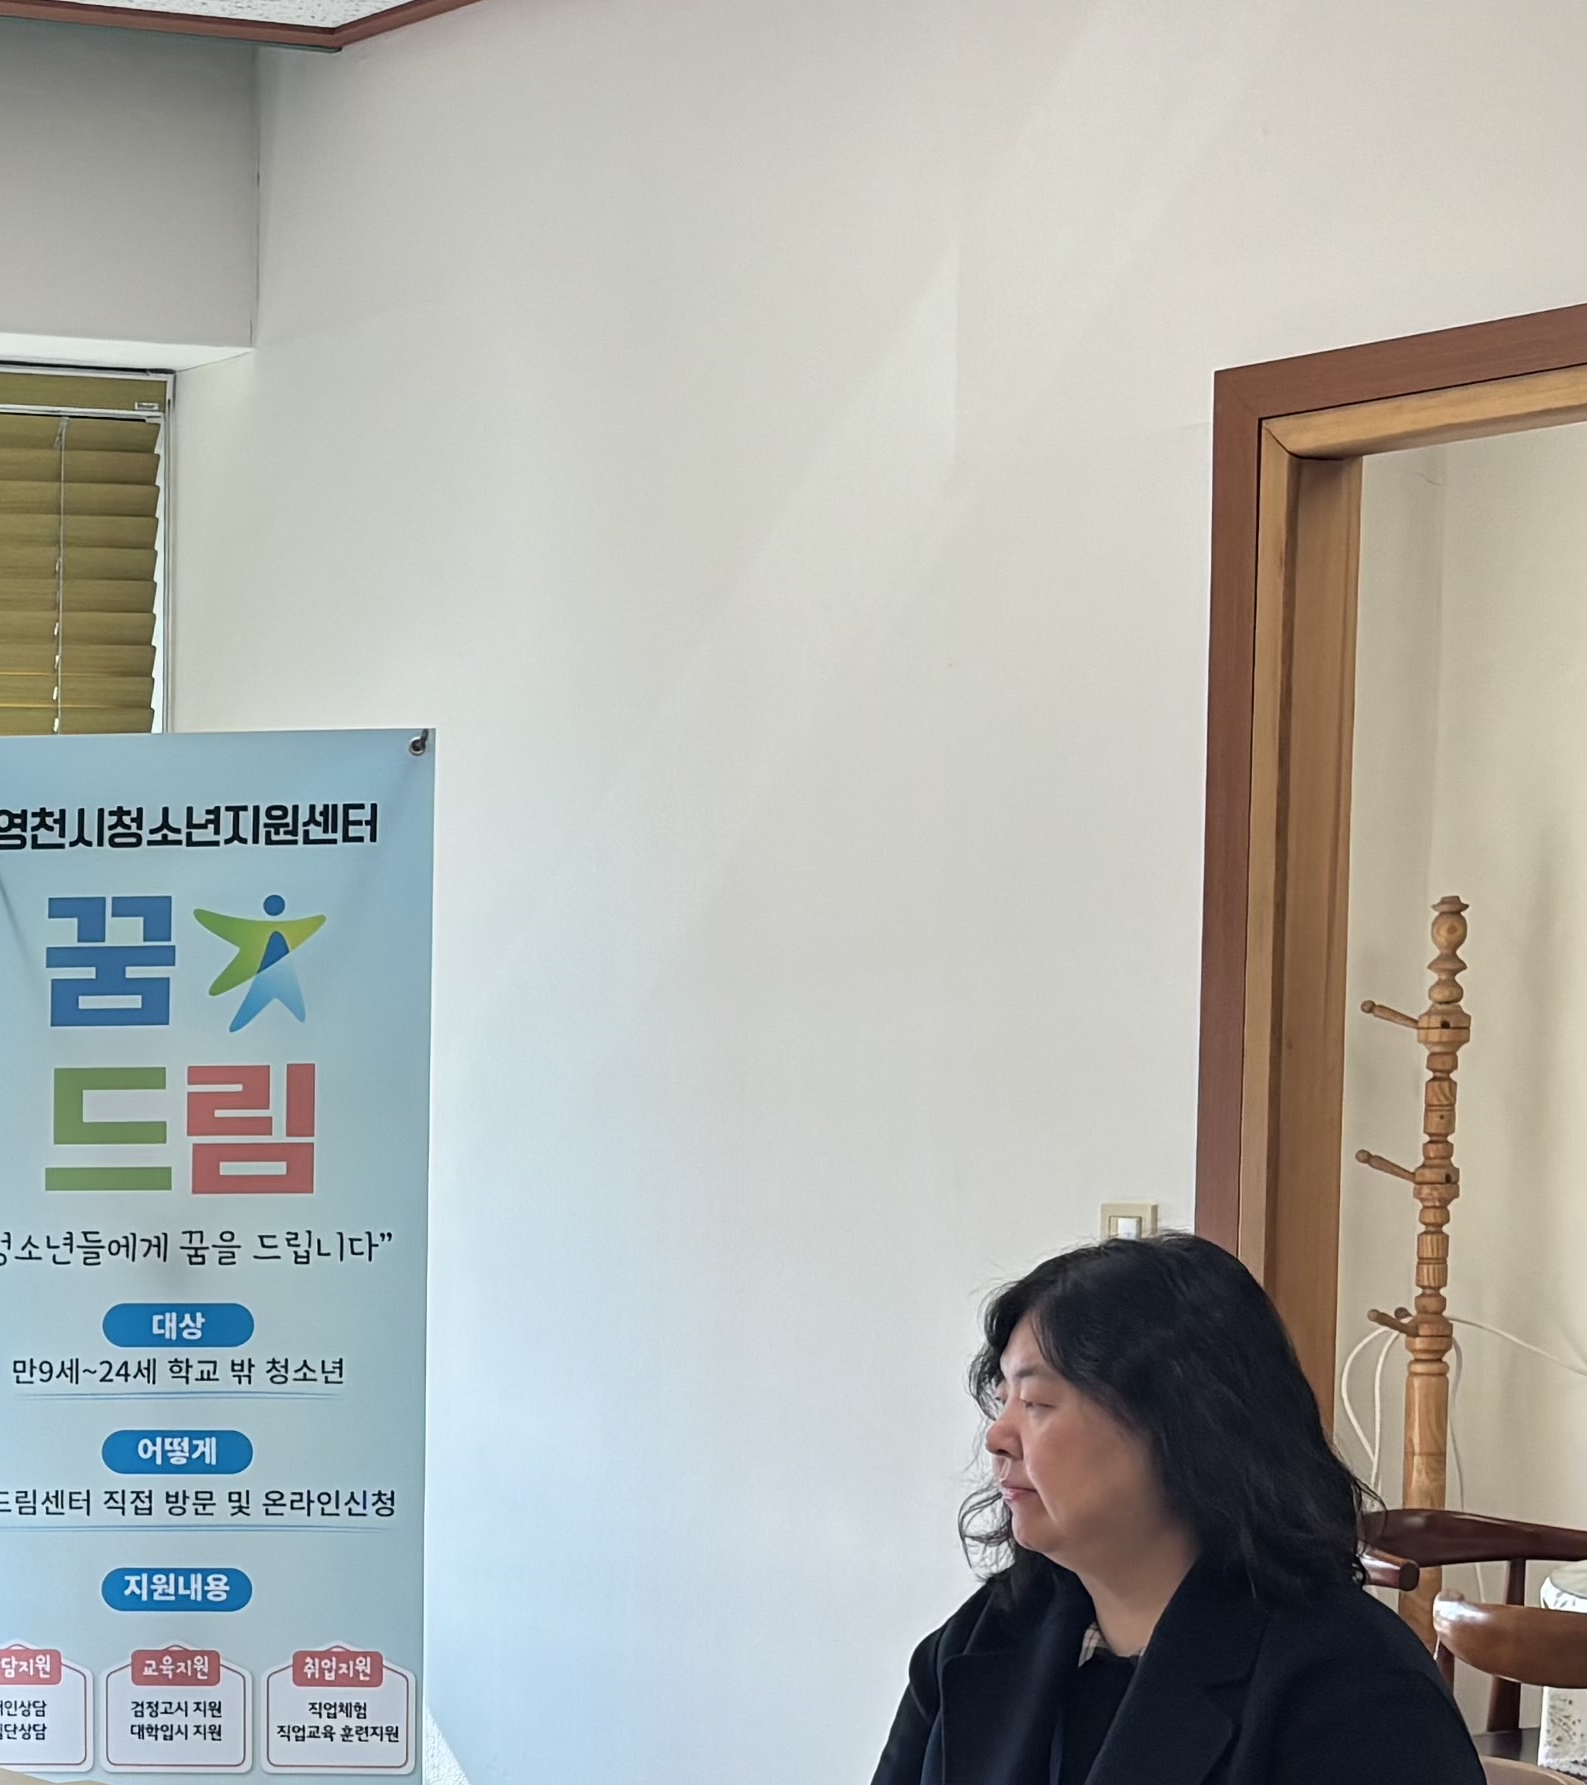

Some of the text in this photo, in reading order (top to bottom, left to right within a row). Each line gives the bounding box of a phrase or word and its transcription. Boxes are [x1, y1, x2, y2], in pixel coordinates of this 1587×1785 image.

[46, 895, 176, 1027] 꿈
[45, 1063, 315, 1195] 드림
[179, 1231, 241, 1266] 꿈을
[152, 1311, 205, 1340] 대상
[12, 1357, 344, 1385] 만9세~24세 학교 밖 청소년
[138, 1436, 217, 1466] 어떻게
[104, 1490, 154, 1517] 직접
[165, 1490, 215, 1517] 방문
[228, 1490, 251, 1517] 및
[262, 1490, 396, 1517] 온라인신청
[124, 1573, 230, 1602] 지원내용
[143, 1656, 209, 1680] 교육지원
[303, 1655, 372, 1681] 취업지원
[131, 1699, 222, 1718] 검정고시 지원
[308, 1700, 367, 1719] 직업체험
[131, 1723, 222, 1742] 대학입시 지원
[276, 1723, 399, 1743] 직업교육 훈련지원
